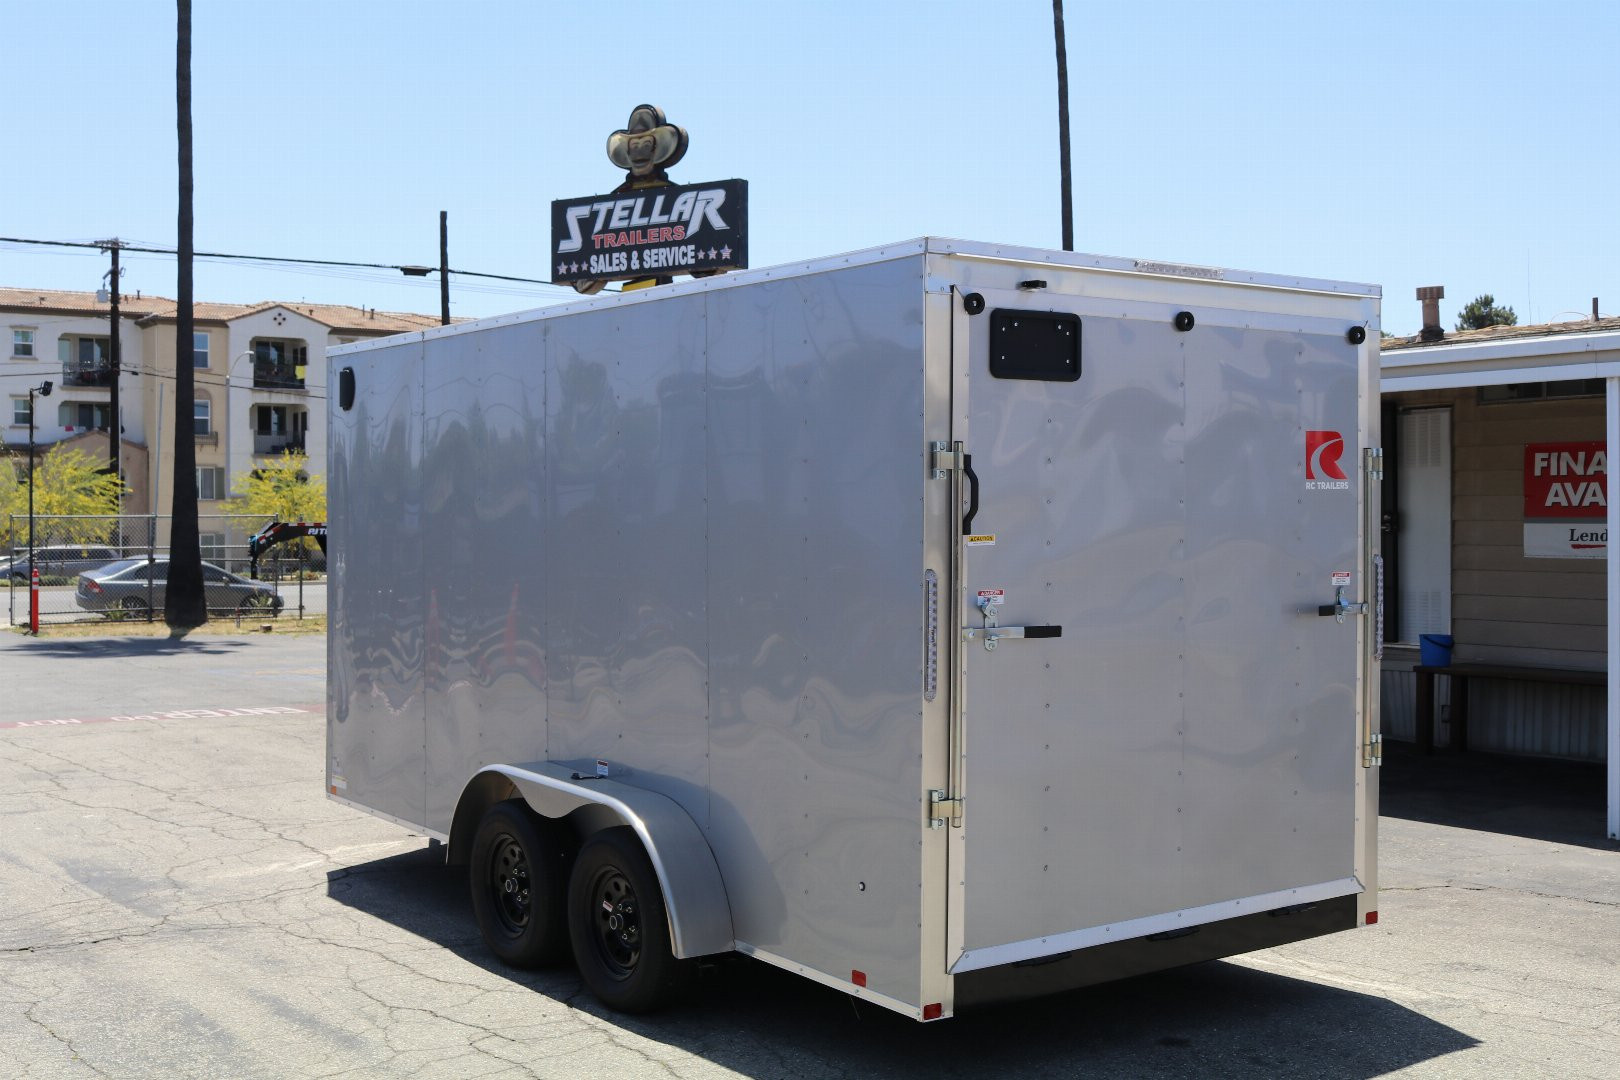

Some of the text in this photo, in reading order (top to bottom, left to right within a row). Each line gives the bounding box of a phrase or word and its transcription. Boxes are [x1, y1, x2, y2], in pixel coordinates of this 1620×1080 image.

[557, 188, 730, 253] STELLAR
[592, 225, 685, 249] TRAILERS
[590, 244, 695, 274] SALES & SERVICE
[1305, 481, 1349, 490] RC TRAILERS
[1545, 482, 1608, 507] AVA
